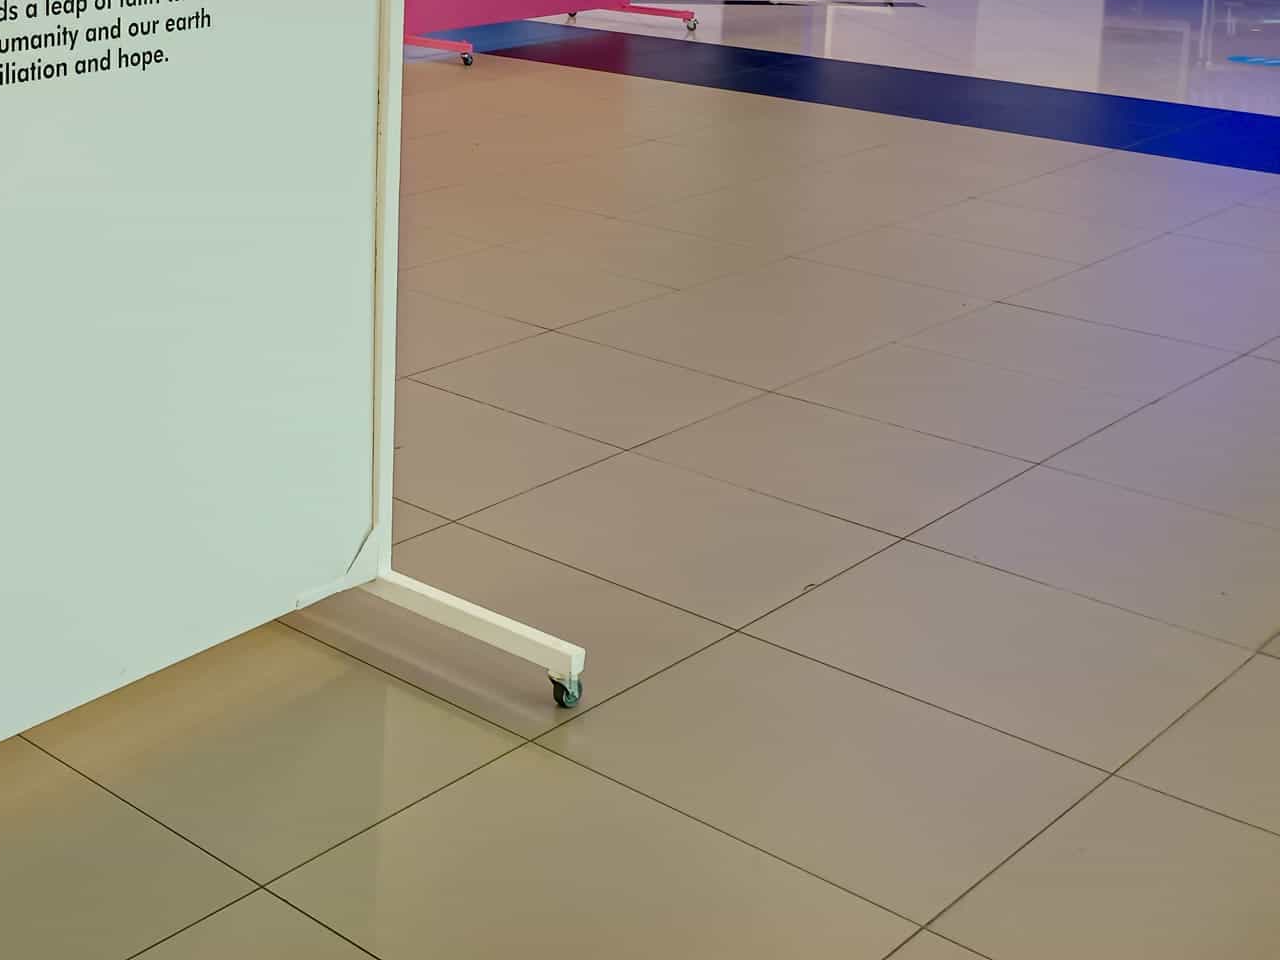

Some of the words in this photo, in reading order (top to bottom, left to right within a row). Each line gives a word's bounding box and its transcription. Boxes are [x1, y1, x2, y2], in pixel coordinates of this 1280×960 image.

[25, 2, 37, 19] a
[85, 17, 121, 42] and
[128, 18, 160, 38] our
[165, 8, 211, 32] earth
[75, 49, 111, 75] and
[119, 48, 169, 71] hope.
